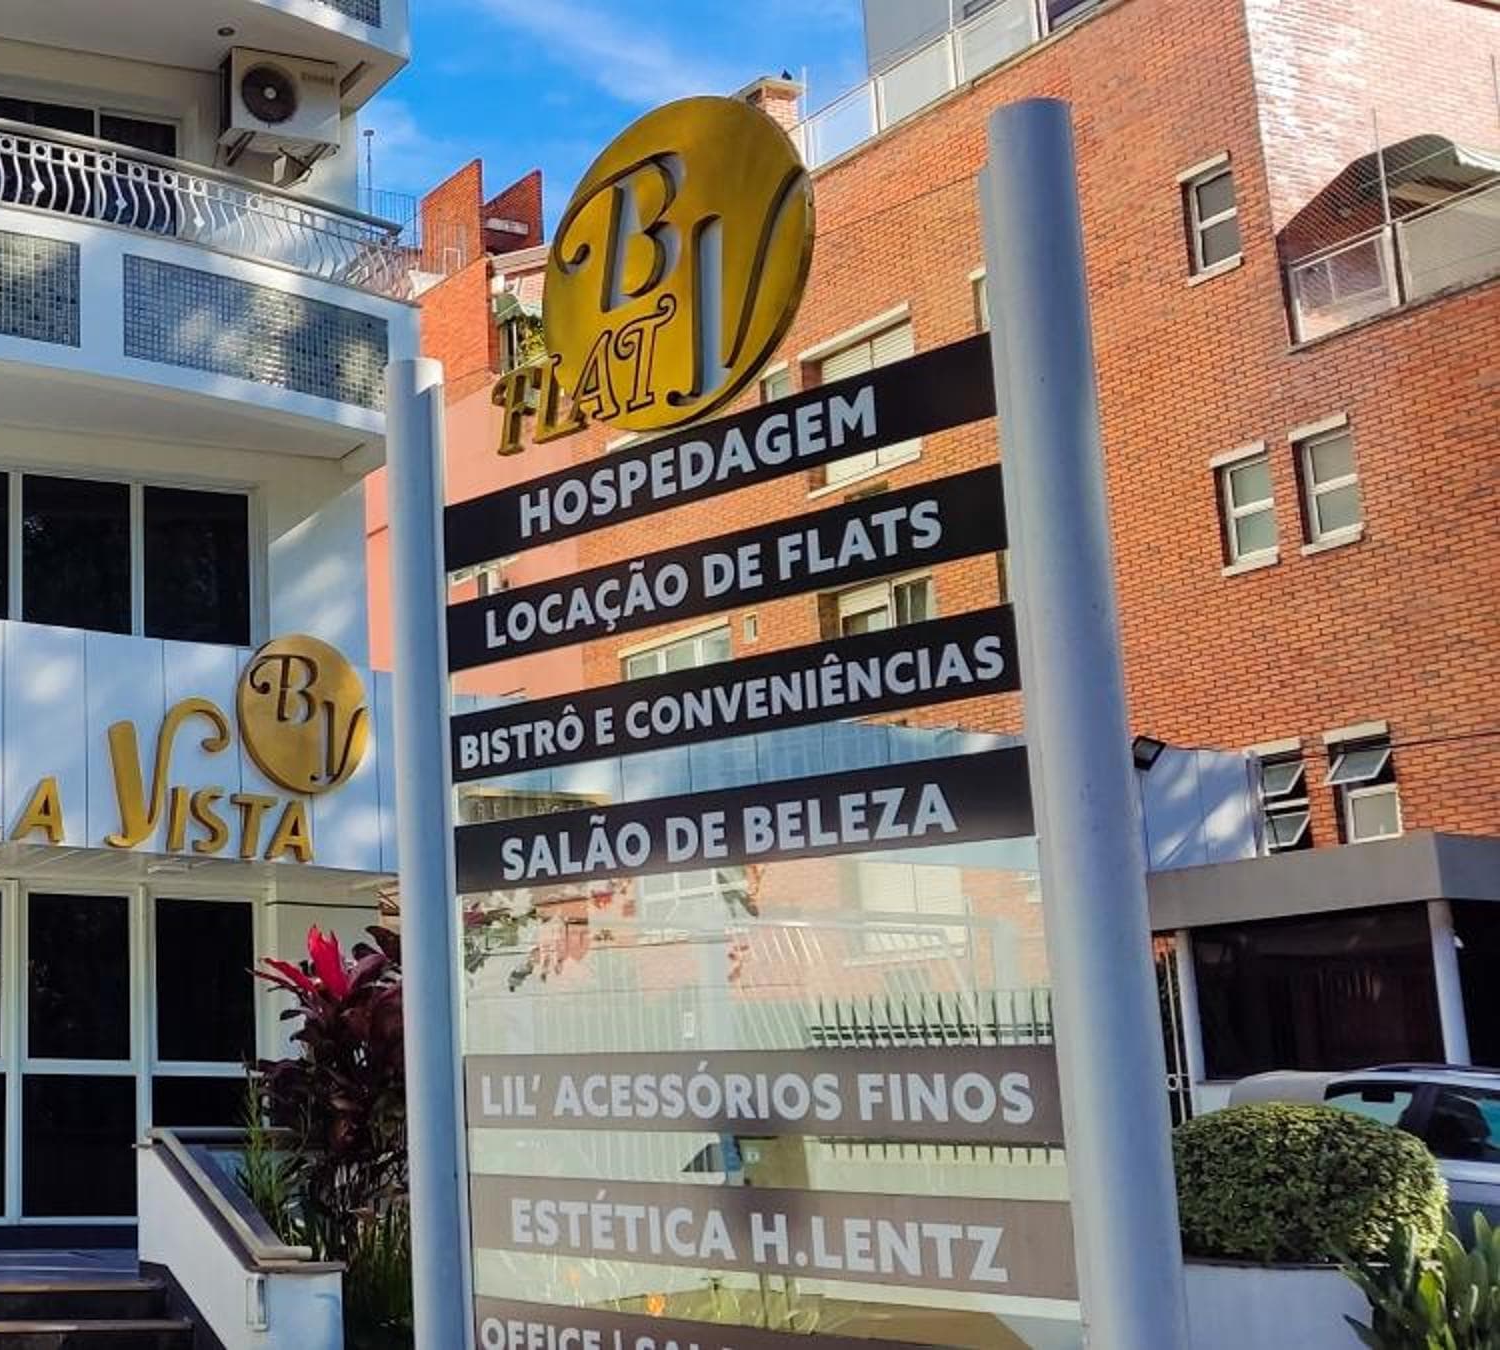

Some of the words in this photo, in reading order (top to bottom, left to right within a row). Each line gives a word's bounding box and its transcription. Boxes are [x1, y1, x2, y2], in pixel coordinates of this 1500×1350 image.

[492, 293, 677, 456] FLAT
[519, 386, 877, 538] HOSPEDAGEM
[485, 560, 689, 649] LOCAÇÃO
[702, 543, 763, 598] DE
[778, 500, 942, 581] FLATS
[460, 703, 585, 769] BISTRÔ
[595, 707, 615, 745] E
[625, 636, 1004, 739] CONVENIÊNCIAS
[104, 697, 315, 863] VISTA
[501, 814, 651, 881] SALÃO
[665, 811, 729, 864] DE
[743, 783, 959, 855] BELEZA
[480, 1073, 541, 1118] LIL'
[553, 1060, 842, 1121] ACESSÓRIOS
[857, 1073, 1034, 1124] FINOS
[510, 1189, 737, 1260] ESTÉTICA
